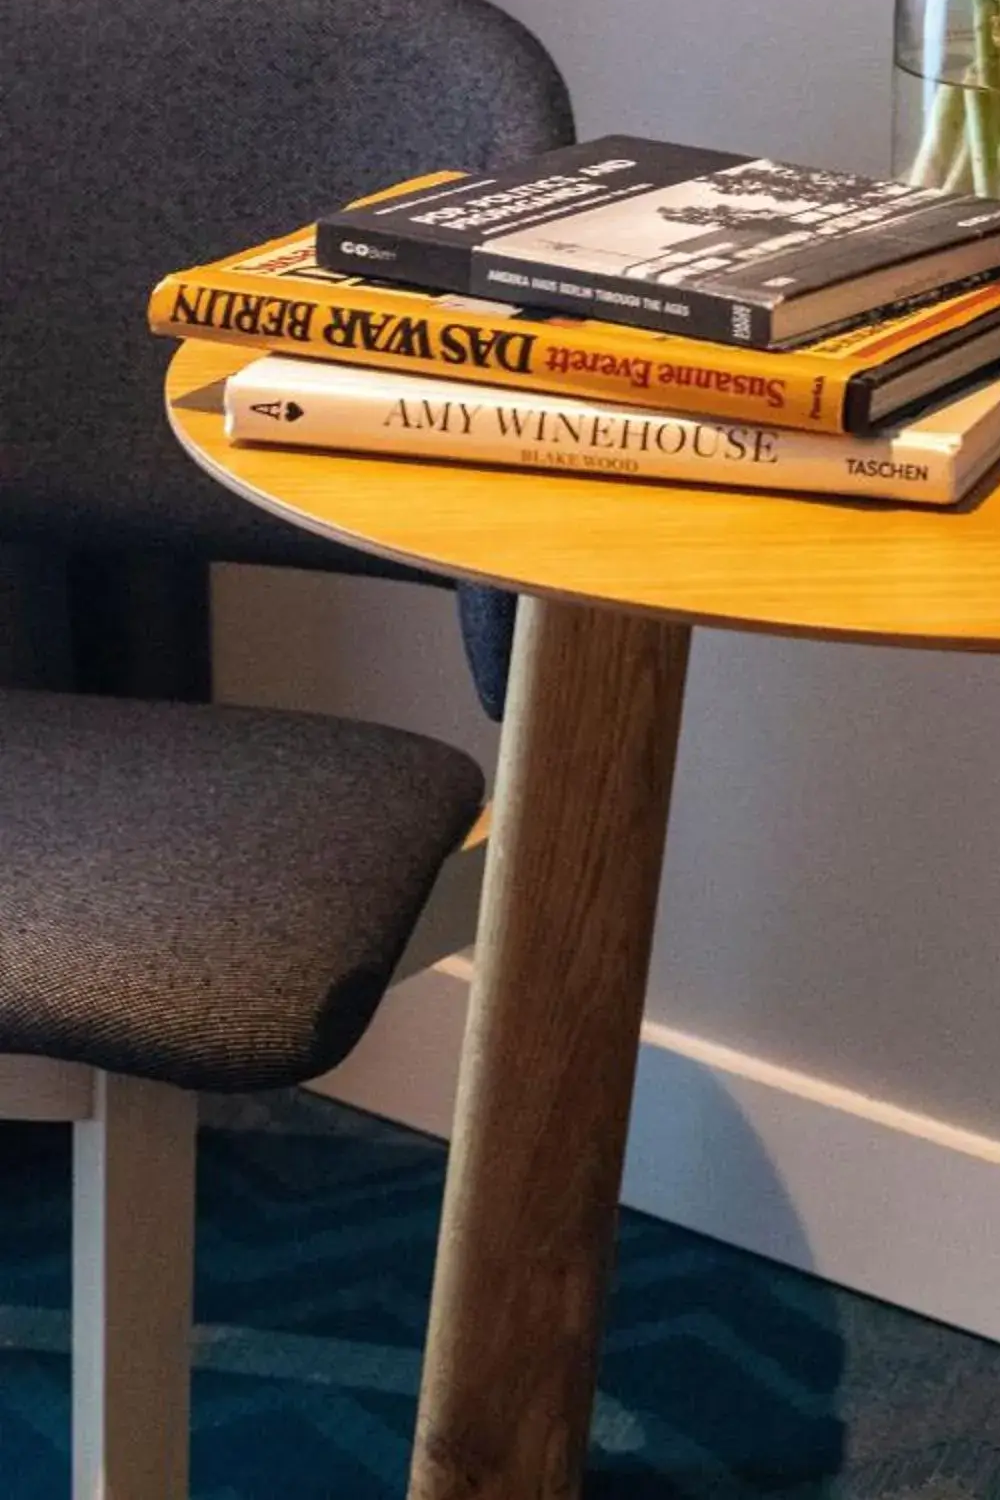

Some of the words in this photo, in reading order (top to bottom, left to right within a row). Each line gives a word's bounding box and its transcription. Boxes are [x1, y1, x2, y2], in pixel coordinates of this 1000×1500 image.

[578, 158, 638, 176] AND
[439, 183, 608, 230] PROPAGANDA
[170, 283, 319, 343] BERLIN
[593, 288, 641, 309] THROUGH
[643, 296, 661, 312] THE
[322, 304, 435, 361] WAR
[440, 323, 538, 375] DAS
[545, 346, 652, 388] Everett
[657, 363, 786, 409] Susanne
[383, 398, 483, 435] AMY
[495, 405, 780, 465] WINEHOUSE
[521, 449, 579, 467] BLAKE
[582, 454, 640, 473] WOOD
[845, 458, 929, 482] TASCHEN
